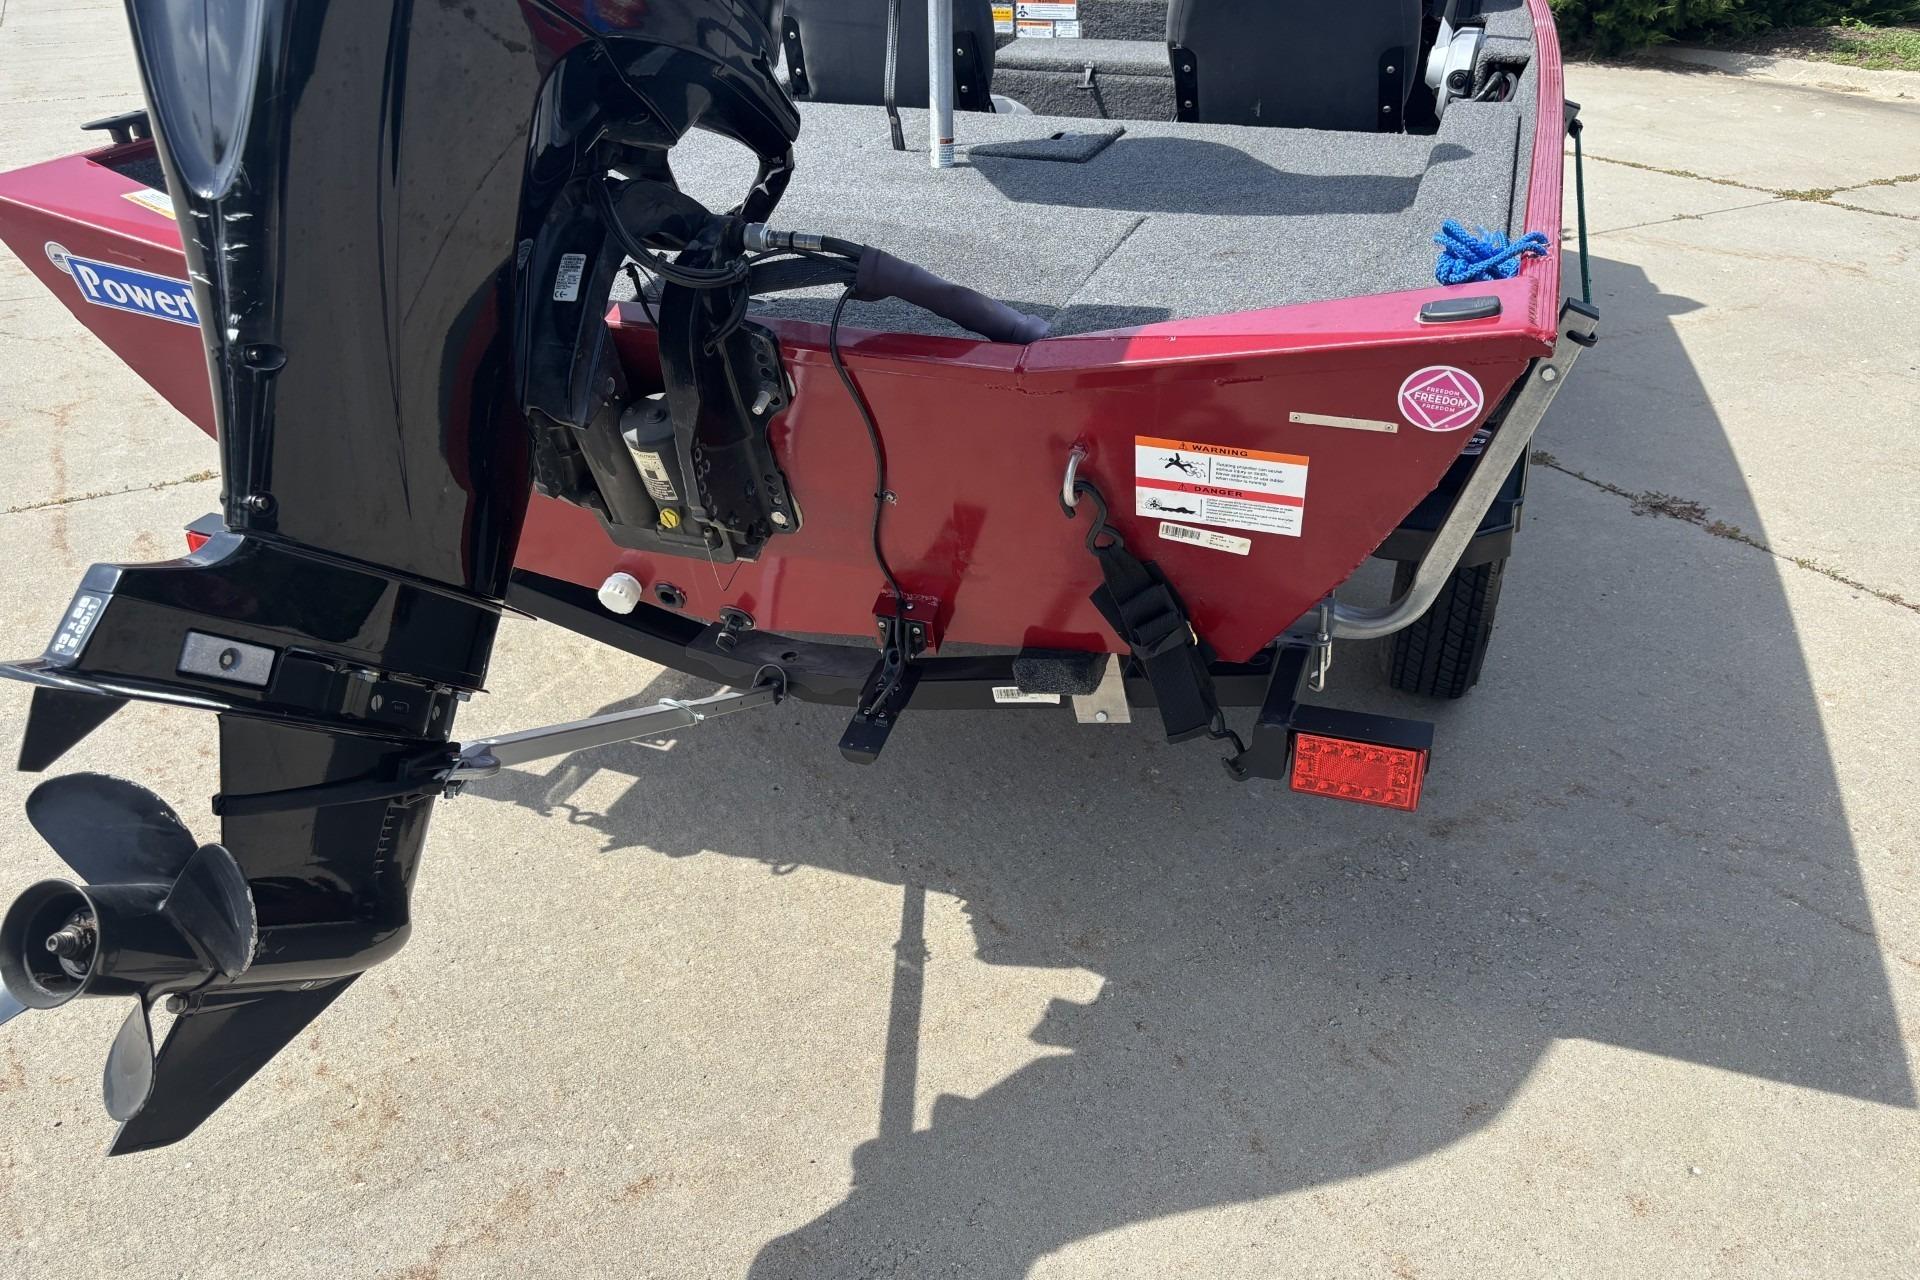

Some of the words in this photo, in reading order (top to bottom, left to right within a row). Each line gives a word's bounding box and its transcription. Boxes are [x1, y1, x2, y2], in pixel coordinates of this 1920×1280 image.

[1426, 386, 1460, 397] FREEDOM
[1414, 391, 1468, 408] FREEDOM
[1422, 403, 1456, 413] FREEDOM
[1192, 444, 1248, 456] WARNING
[1194, 486, 1243, 497] DANGER
[55, 633, 71, 651] 13
